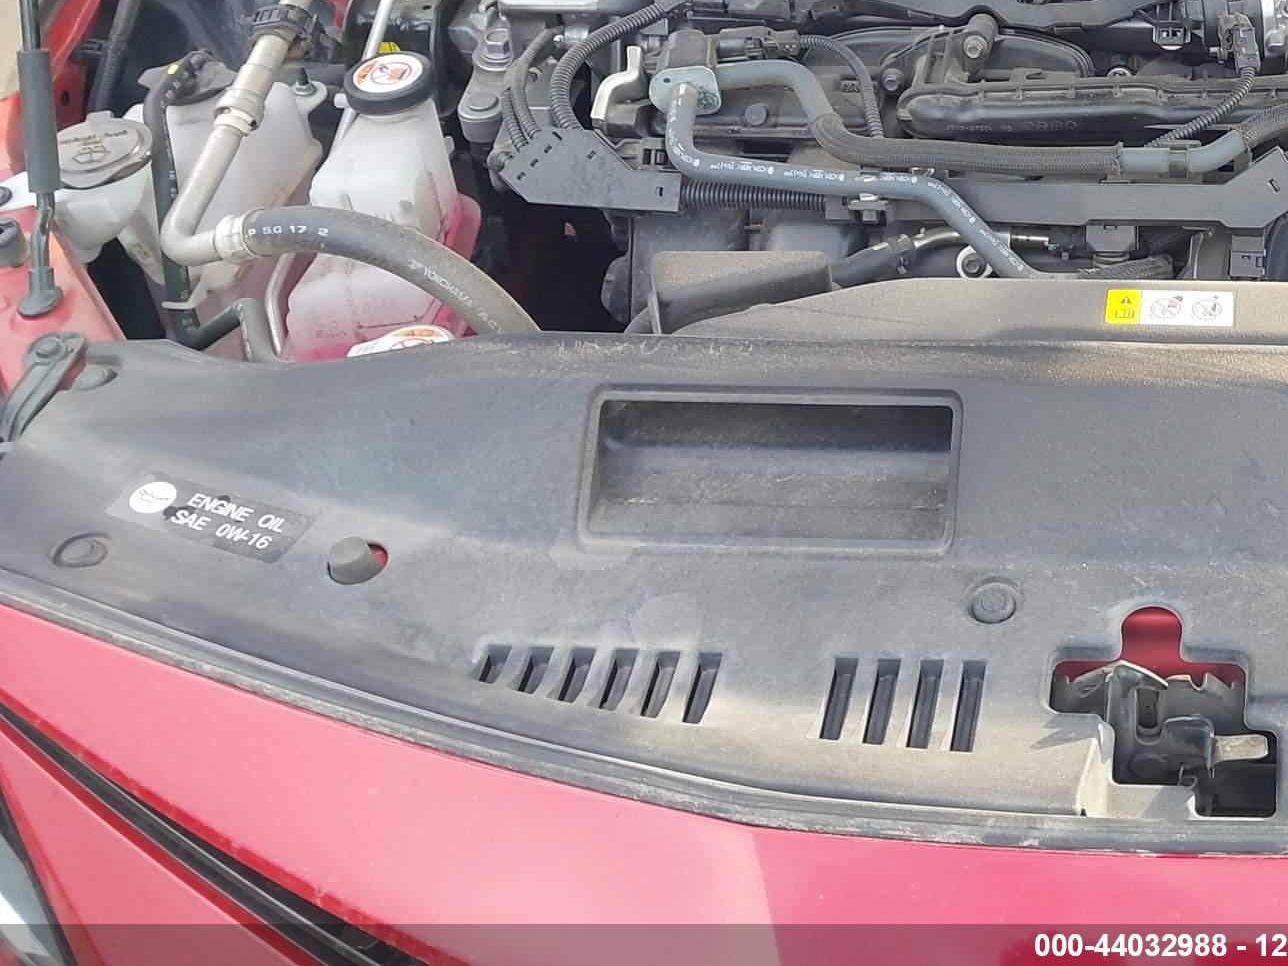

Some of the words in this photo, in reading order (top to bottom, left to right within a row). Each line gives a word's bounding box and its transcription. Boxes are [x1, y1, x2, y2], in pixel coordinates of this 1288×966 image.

[170, 509, 211, 531] SAE
[217, 523, 272, 549] 0W-16
[187, 493, 254, 522] ENGINE
[257, 514, 285, 532] OIL
